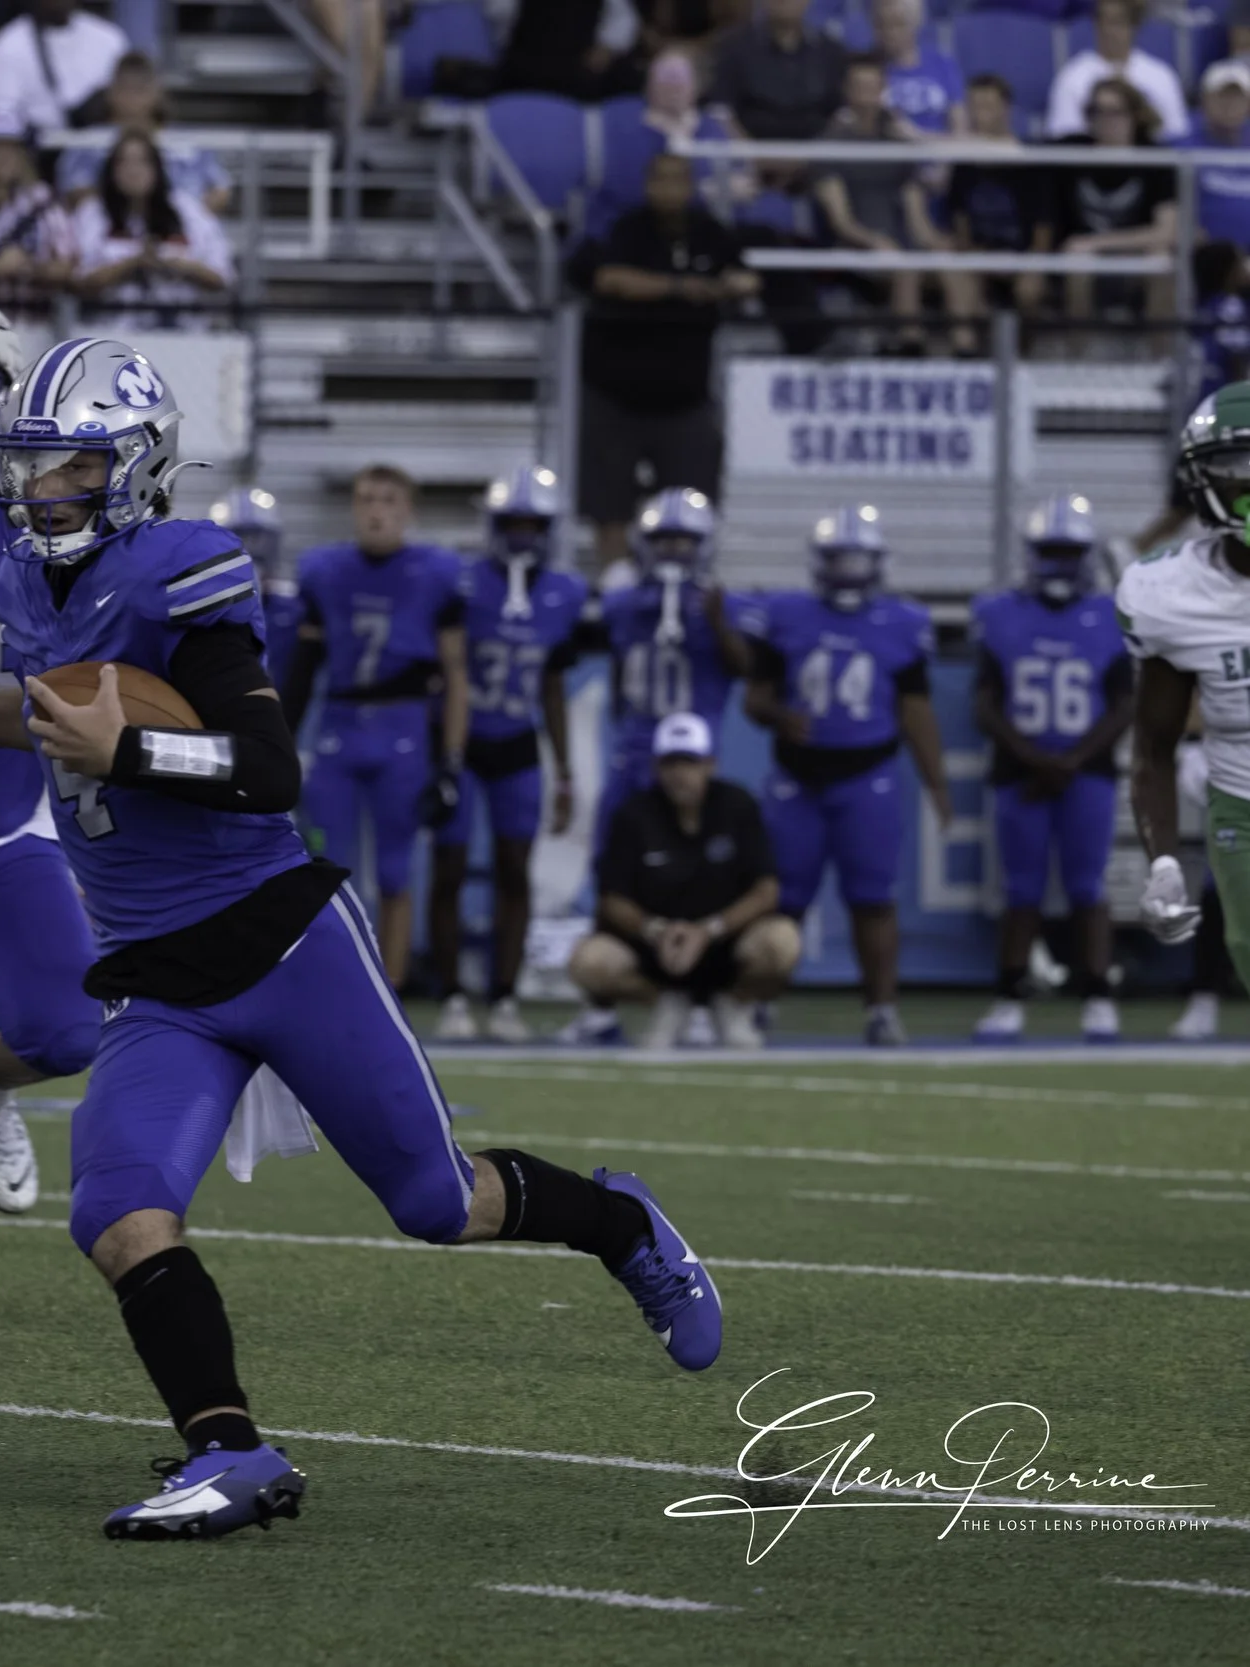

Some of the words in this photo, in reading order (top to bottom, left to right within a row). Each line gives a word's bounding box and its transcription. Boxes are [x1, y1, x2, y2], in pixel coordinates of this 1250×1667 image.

[116, 361, 163, 408] M
[771, 375, 993, 413] RESERVED
[791, 426, 972, 465] SEATING
[800, 649, 874, 719] 44
[1012, 656, 1093, 736] 56
